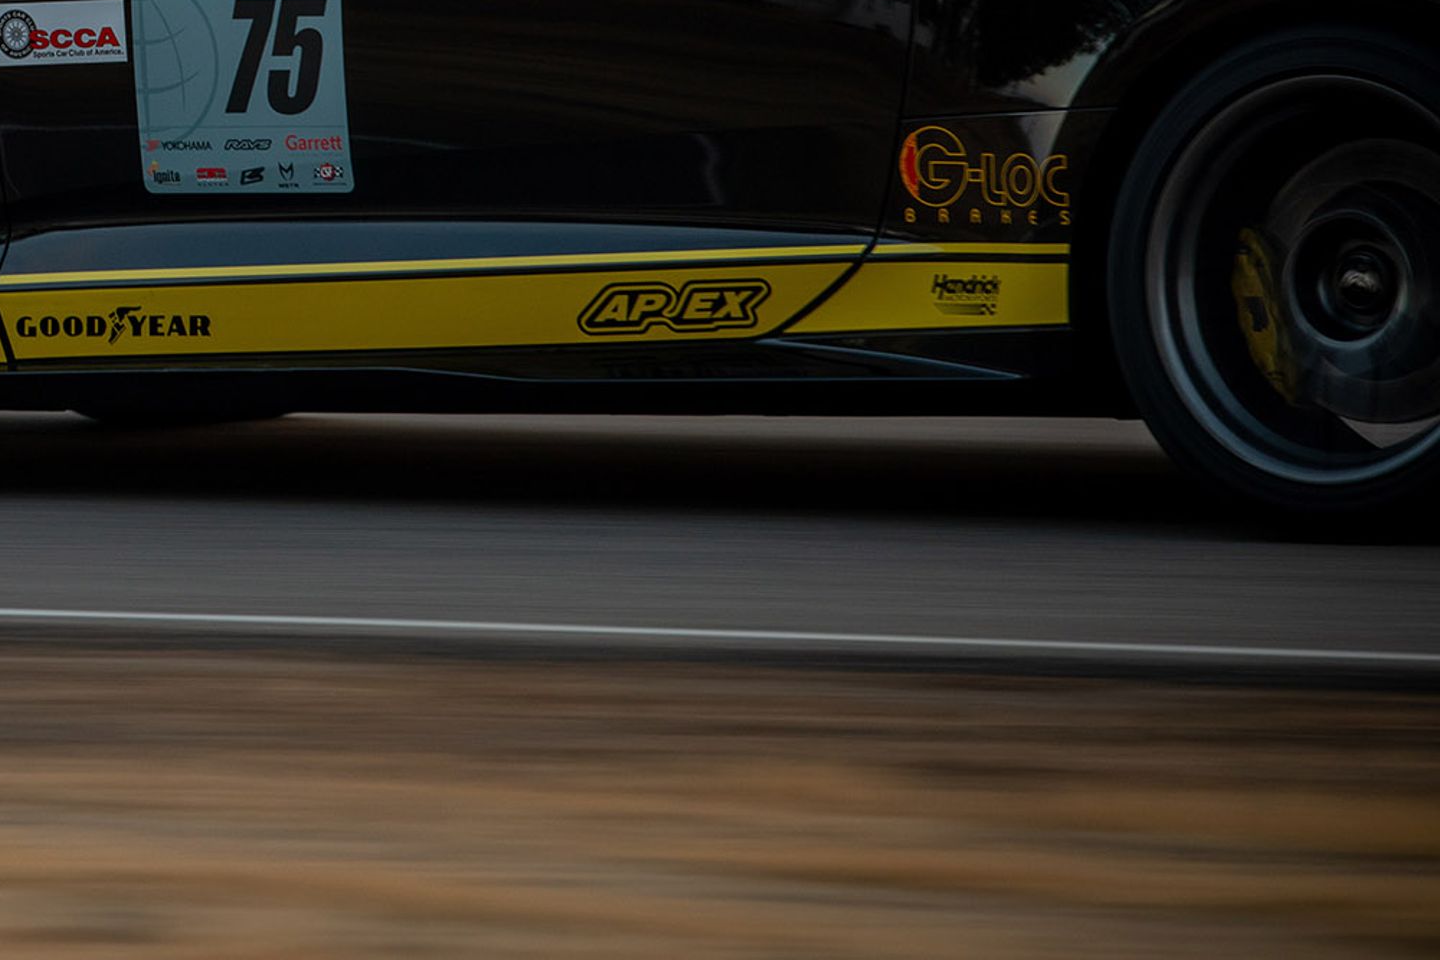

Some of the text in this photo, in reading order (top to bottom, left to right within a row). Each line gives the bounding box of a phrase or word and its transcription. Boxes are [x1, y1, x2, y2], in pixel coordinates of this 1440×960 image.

[29, 26, 121, 50] SCCA
[33, 50, 55, 59] Sports
[56, 50, 68, 58] Car
[69, 49, 86, 57] Club
[86, 49, 94, 57] of
[161, 141, 213, 151] YOKOHAMA
[224, 138, 272, 151] RAYS
[284, 135, 343, 151] Garrett
[899, 125, 1069, 207] G-LOC
[904, 208, 1071, 225] BRAKES
[931, 274, 1001, 300] Hendrick
[590, 288, 757, 325] APEX
